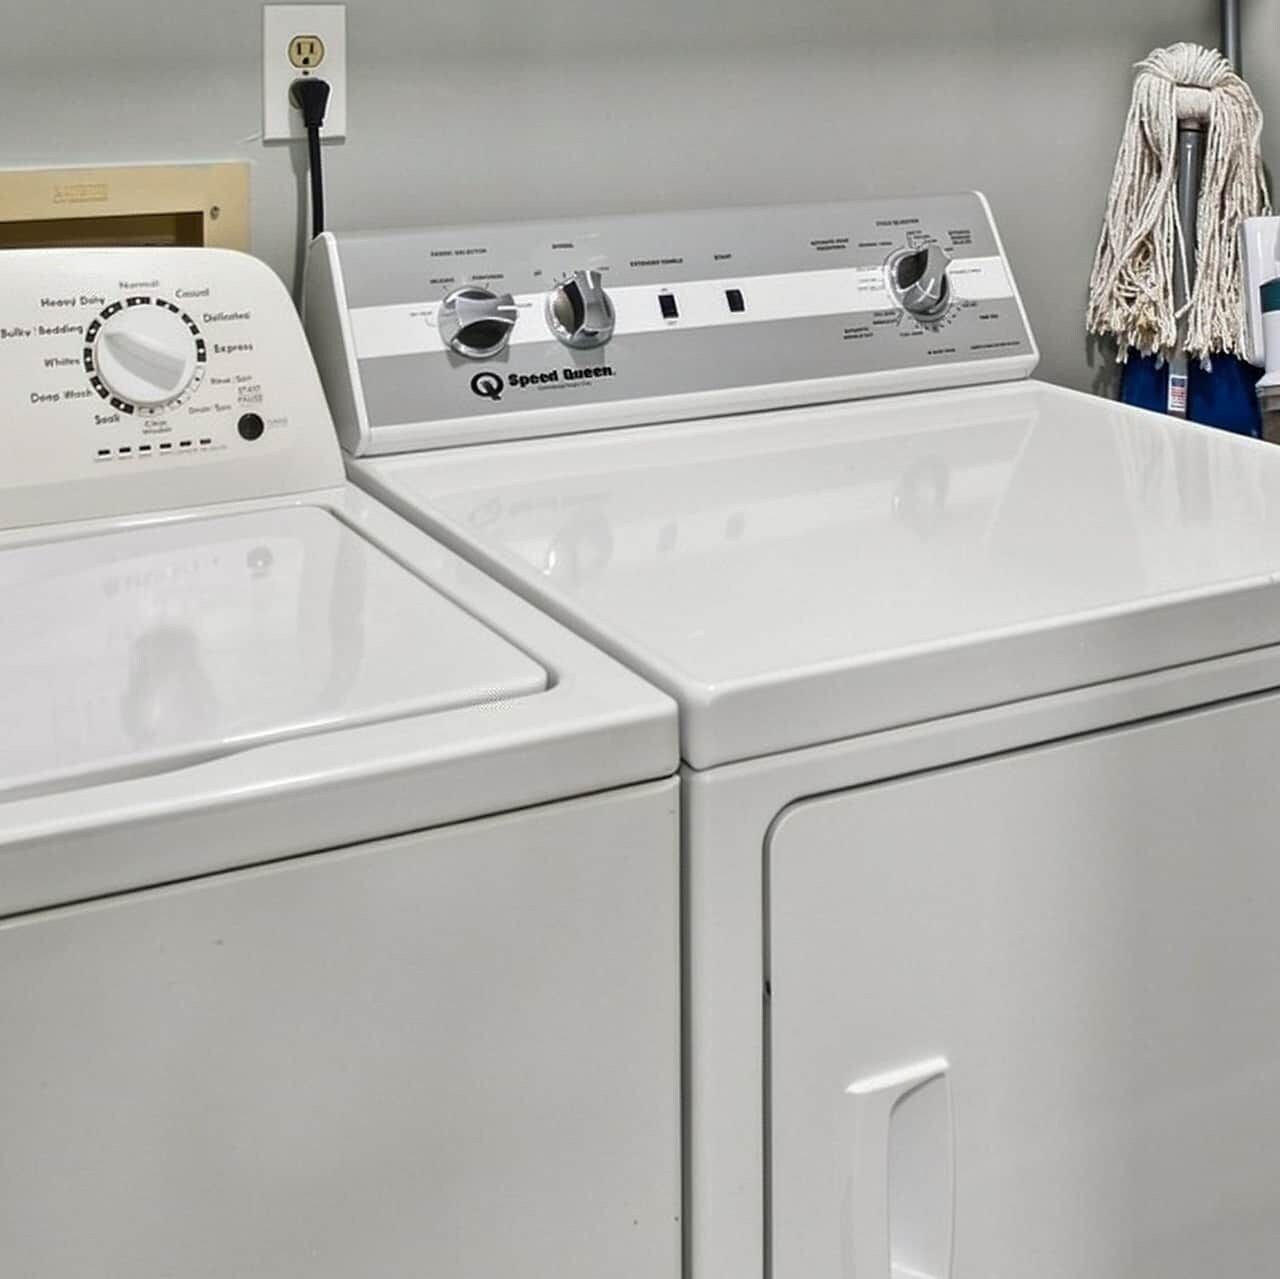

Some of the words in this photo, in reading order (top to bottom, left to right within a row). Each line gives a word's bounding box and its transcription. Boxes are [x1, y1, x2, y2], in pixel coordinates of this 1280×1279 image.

[175, 288, 210, 298] Casual
[40, 297, 76, 307] Heavy
[79, 296, 105, 306] Duty
[202, 312, 251, 323] Delicates
[213, 343, 254, 355] Express
[43, 357, 81, 368] Whites
[507, 369, 560, 388] Speed
[562, 365, 614, 381] Queen
[29, 392, 60, 405] Deep
[63, 387, 93, 399] Wash
[94, 414, 120, 425] Soak
